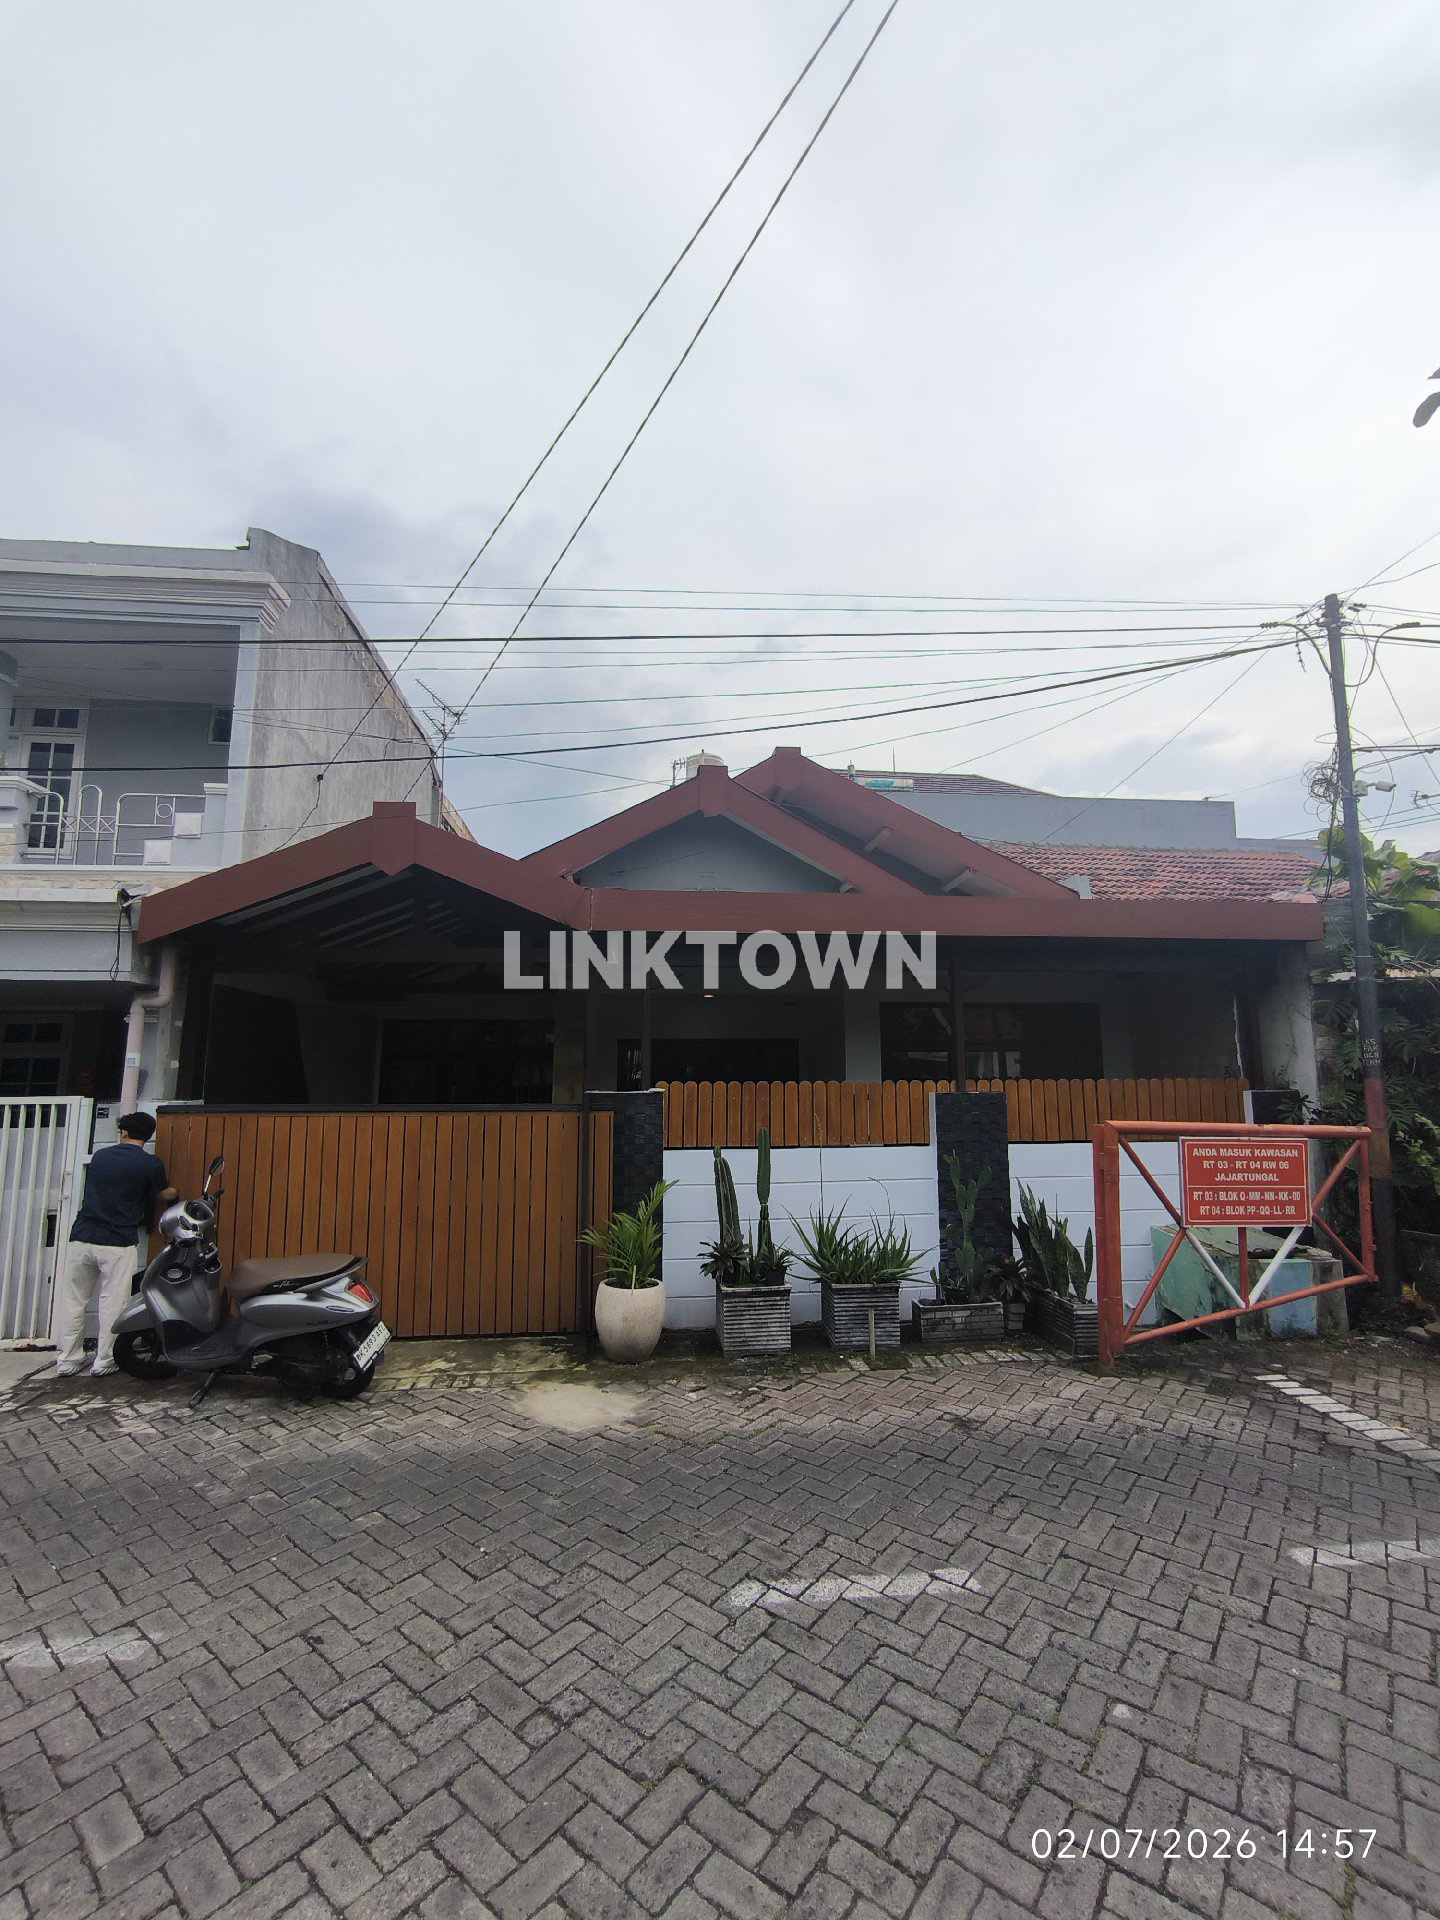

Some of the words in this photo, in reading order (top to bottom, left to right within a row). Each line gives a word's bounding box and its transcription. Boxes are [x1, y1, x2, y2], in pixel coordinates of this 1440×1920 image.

[1192, 1148, 1218, 1157] ANDA
[1219, 1148, 1252, 1157] MASUK
[1254, 1148, 1298, 1157] KAWASAN
[1203, 1160, 1215, 1169] RT
[1217, 1160, 1229, 1169] 03
[1235, 1160, 1248, 1169] RT
[1249, 1160, 1261, 1169] 04
[1262, 1160, 1277, 1169] RW
[1278, 1161, 1290, 1170] 06
[1214, 1172, 1280, 1182] JAJARTUNGAL
[1193, 1191, 1204, 1201] RT
[1204, 1191, 1213, 1201] 03
[1219, 1191, 1238, 1201] BLOK
[1199, 1205, 1210, 1215] RT
[1211, 1205, 1220, 1215] 04
[1225, 1205, 1246, 1215] BLOK
